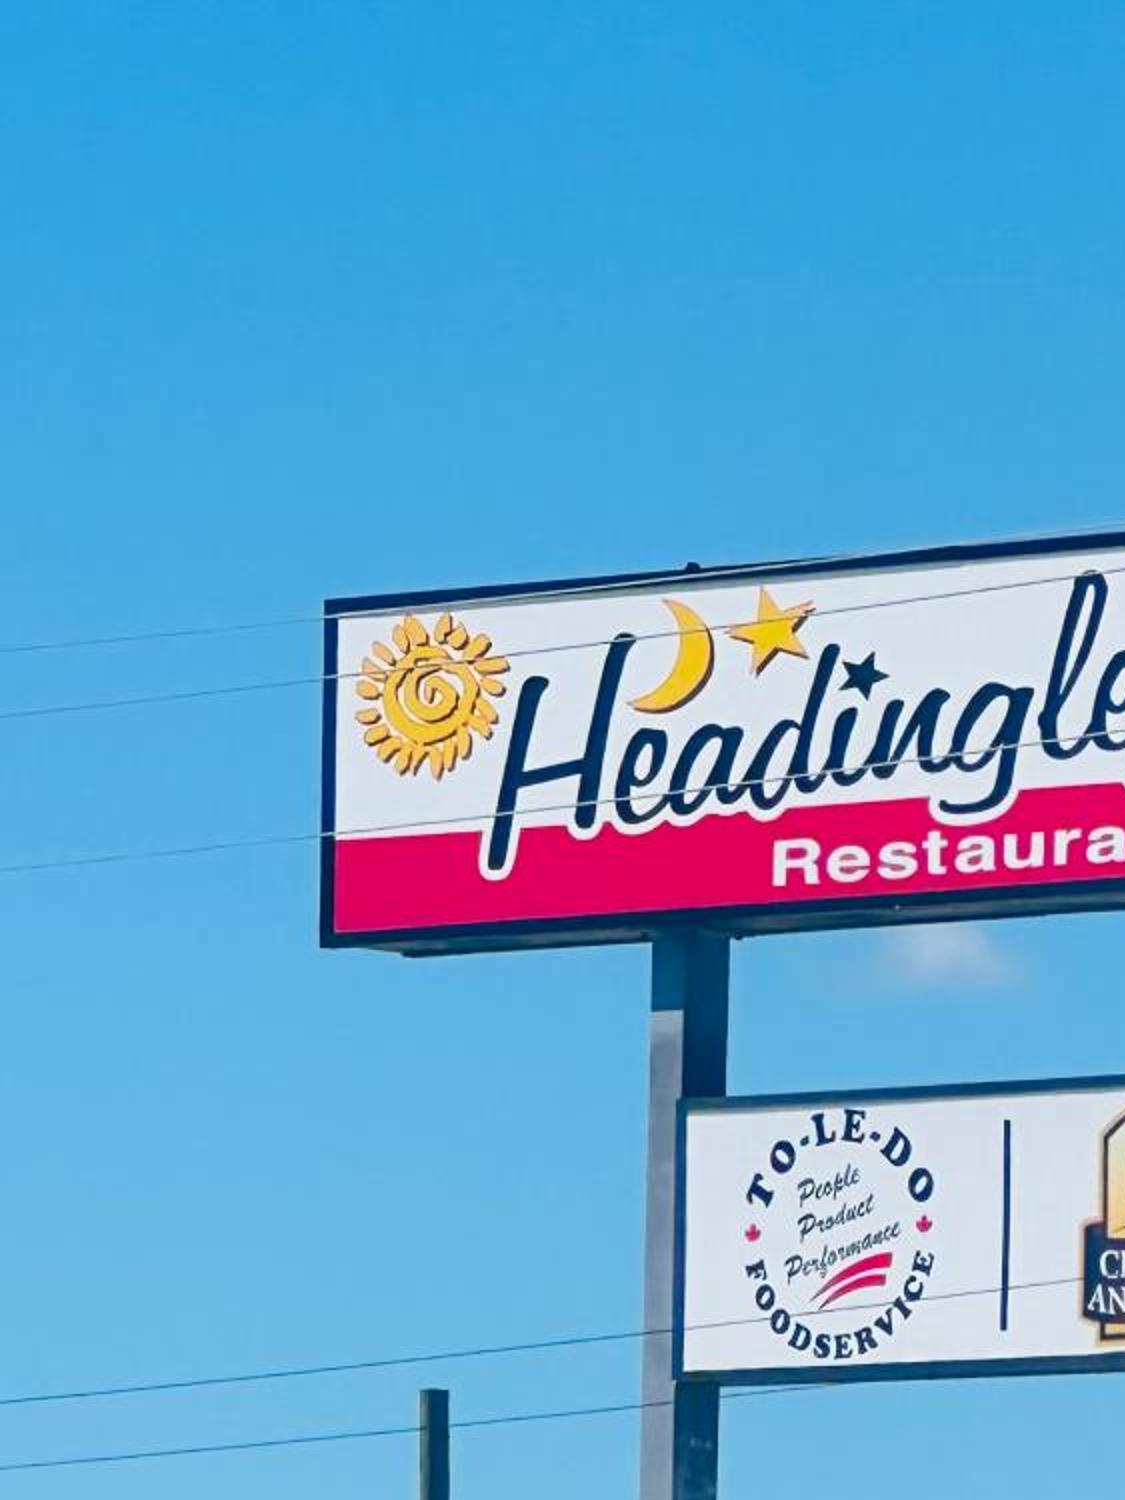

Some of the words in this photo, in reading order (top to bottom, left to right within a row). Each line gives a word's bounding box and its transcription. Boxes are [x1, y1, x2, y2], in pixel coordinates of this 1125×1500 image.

[797, 1163, 860, 1208] People
[797, 1193, 875, 1243] Product
[784, 1220, 902, 1285] Performance
[745, 1250, 935, 1360] FOODSERVICE
